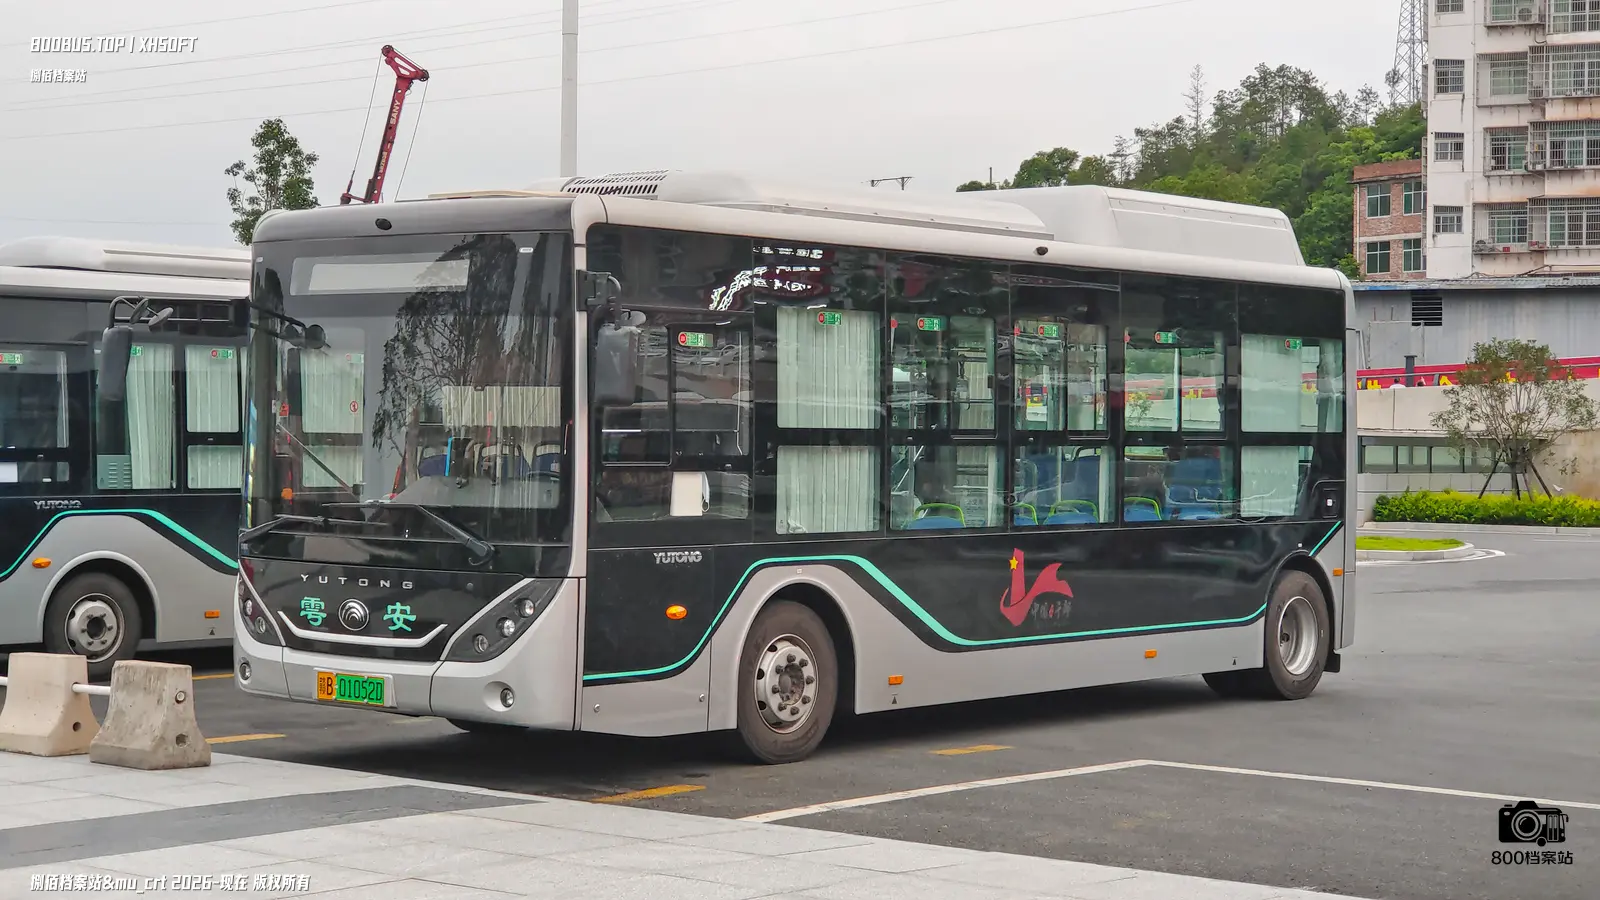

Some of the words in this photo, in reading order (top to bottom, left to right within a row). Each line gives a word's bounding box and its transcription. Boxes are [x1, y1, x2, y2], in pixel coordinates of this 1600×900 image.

[390, 99, 400, 125] SANY
[33, 500, 82, 510] YUTONG
[653, 550, 703, 565] YUTONG
[300, 573, 414, 589] YUTONG
